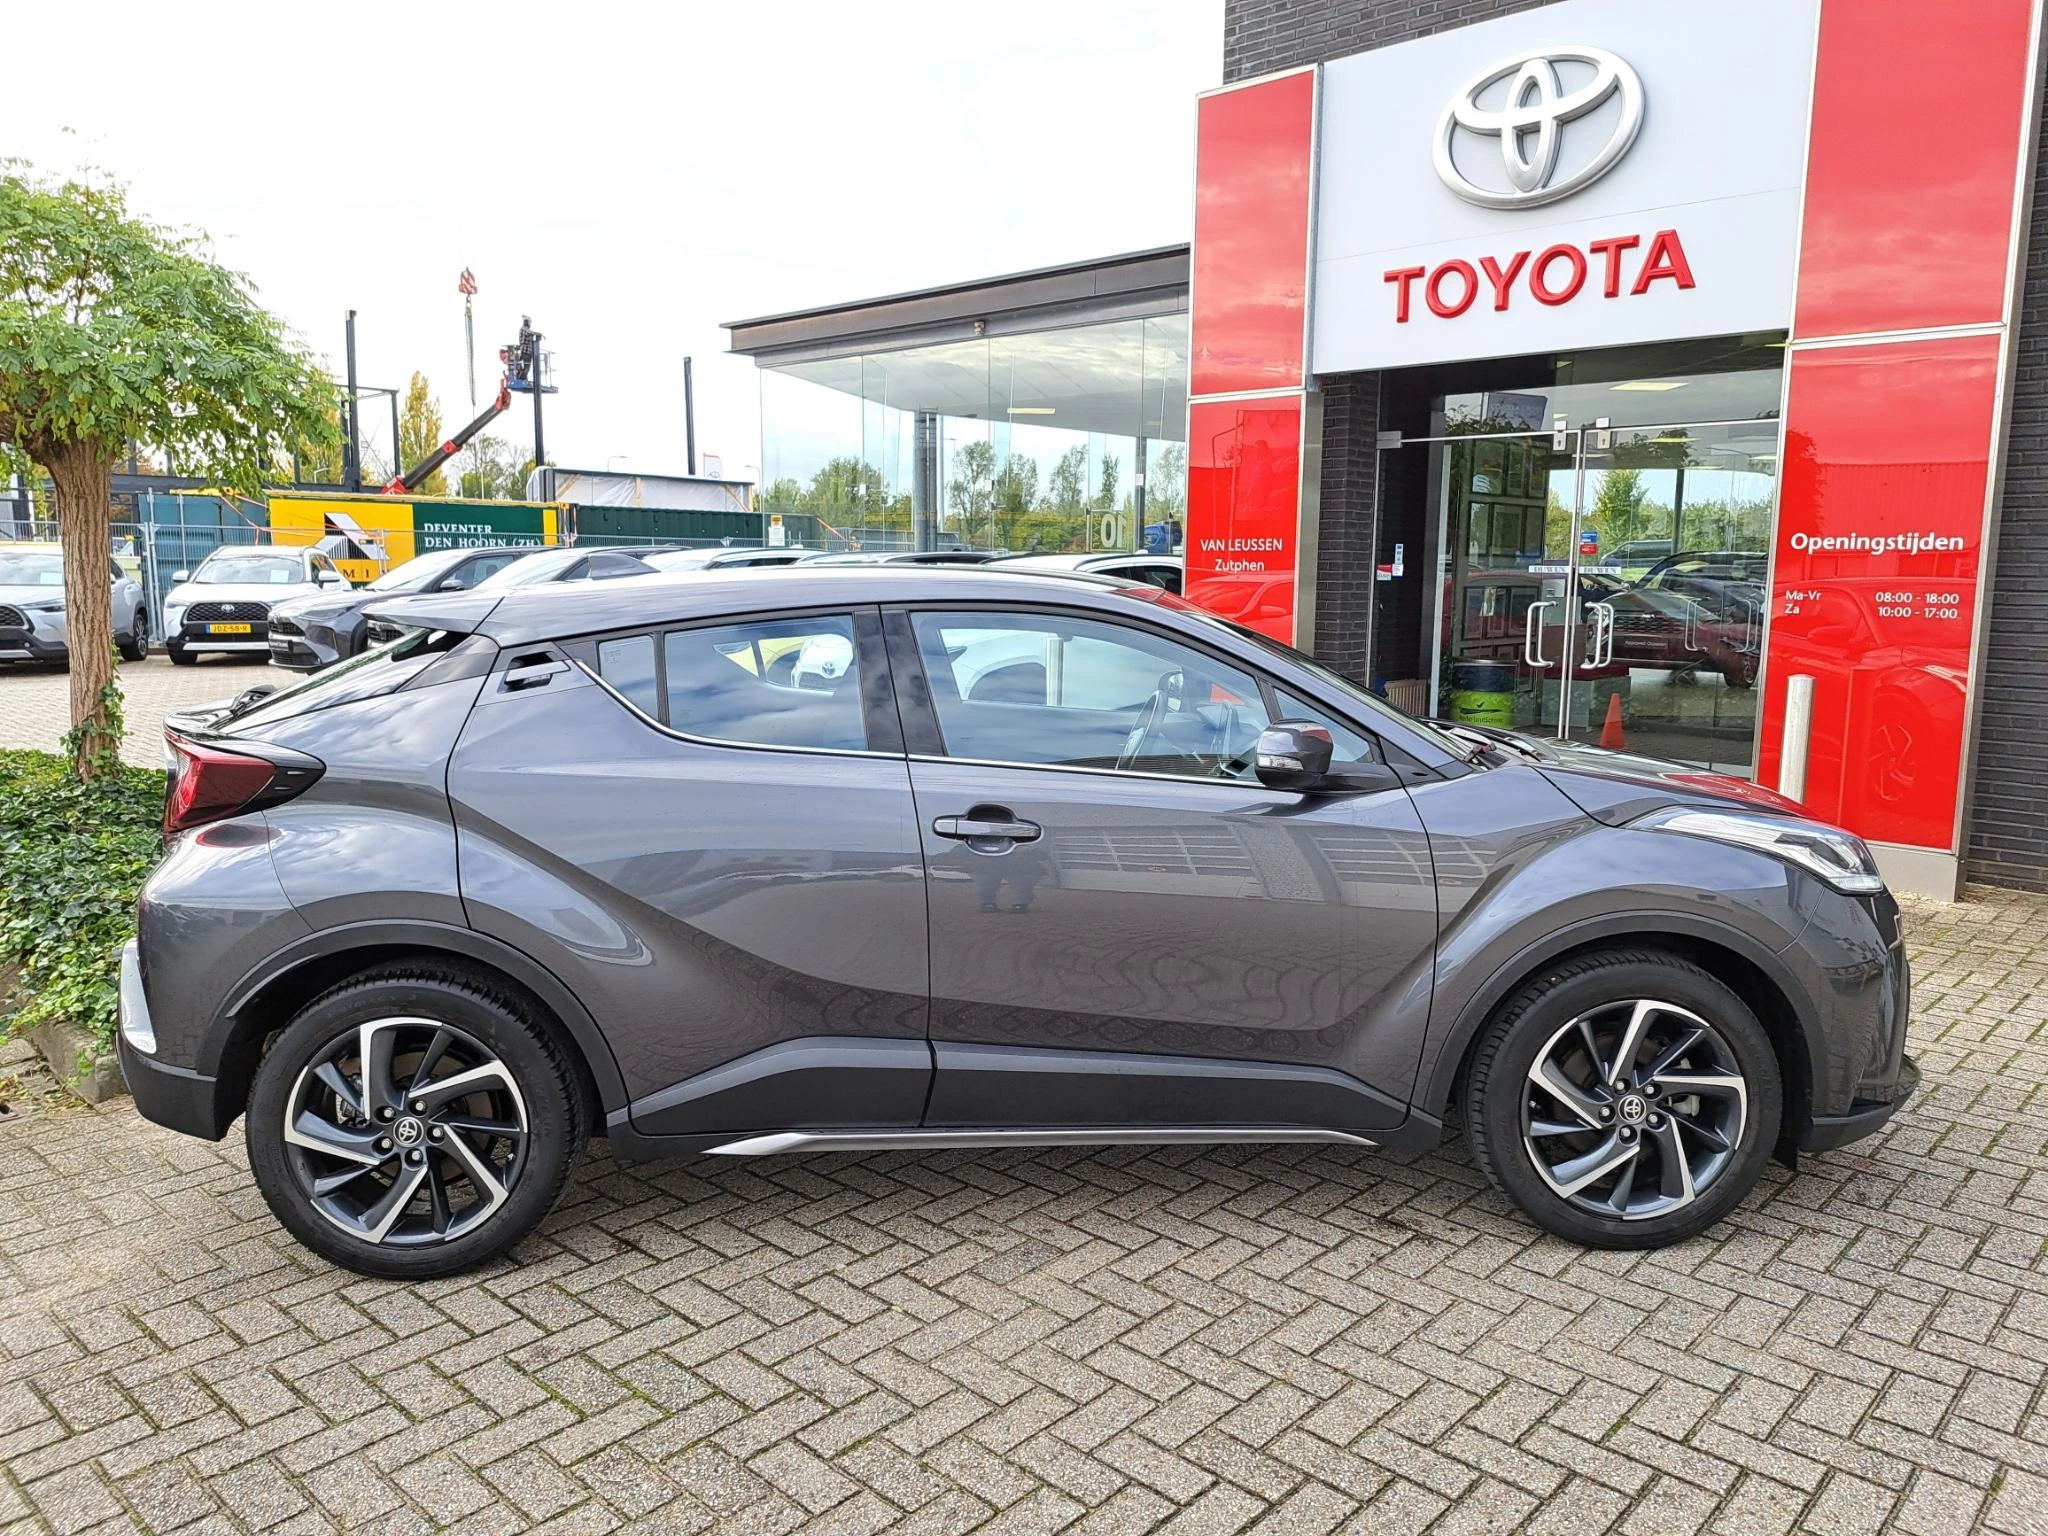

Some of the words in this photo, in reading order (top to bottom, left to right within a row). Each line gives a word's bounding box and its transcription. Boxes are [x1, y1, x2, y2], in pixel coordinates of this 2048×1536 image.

[1383, 228, 1696, 323] TOYOTA
[424, 523, 492, 534] DEVENTER
[425, 537, 452, 547] DEN
[459, 537, 506, 547] HOORN
[512, 538, 541, 547] (ZH)
[1200, 539, 1225, 551] VAN
[1228, 538, 1283, 551] LEUSSEN
[1790, 531, 1964, 555] Openingstijden
[1215, 558, 1265, 574] Zutphen
[1785, 590, 1822, 601] Ma-Vr
[1875, 592, 1912, 603] 08:00
[1925, 593, 1960, 604] 18:00
[1784, 603, 1800, 614] Za
[1878, 606, 1912, 617] 10:00
[1924, 607, 1958, 619] 17:00
